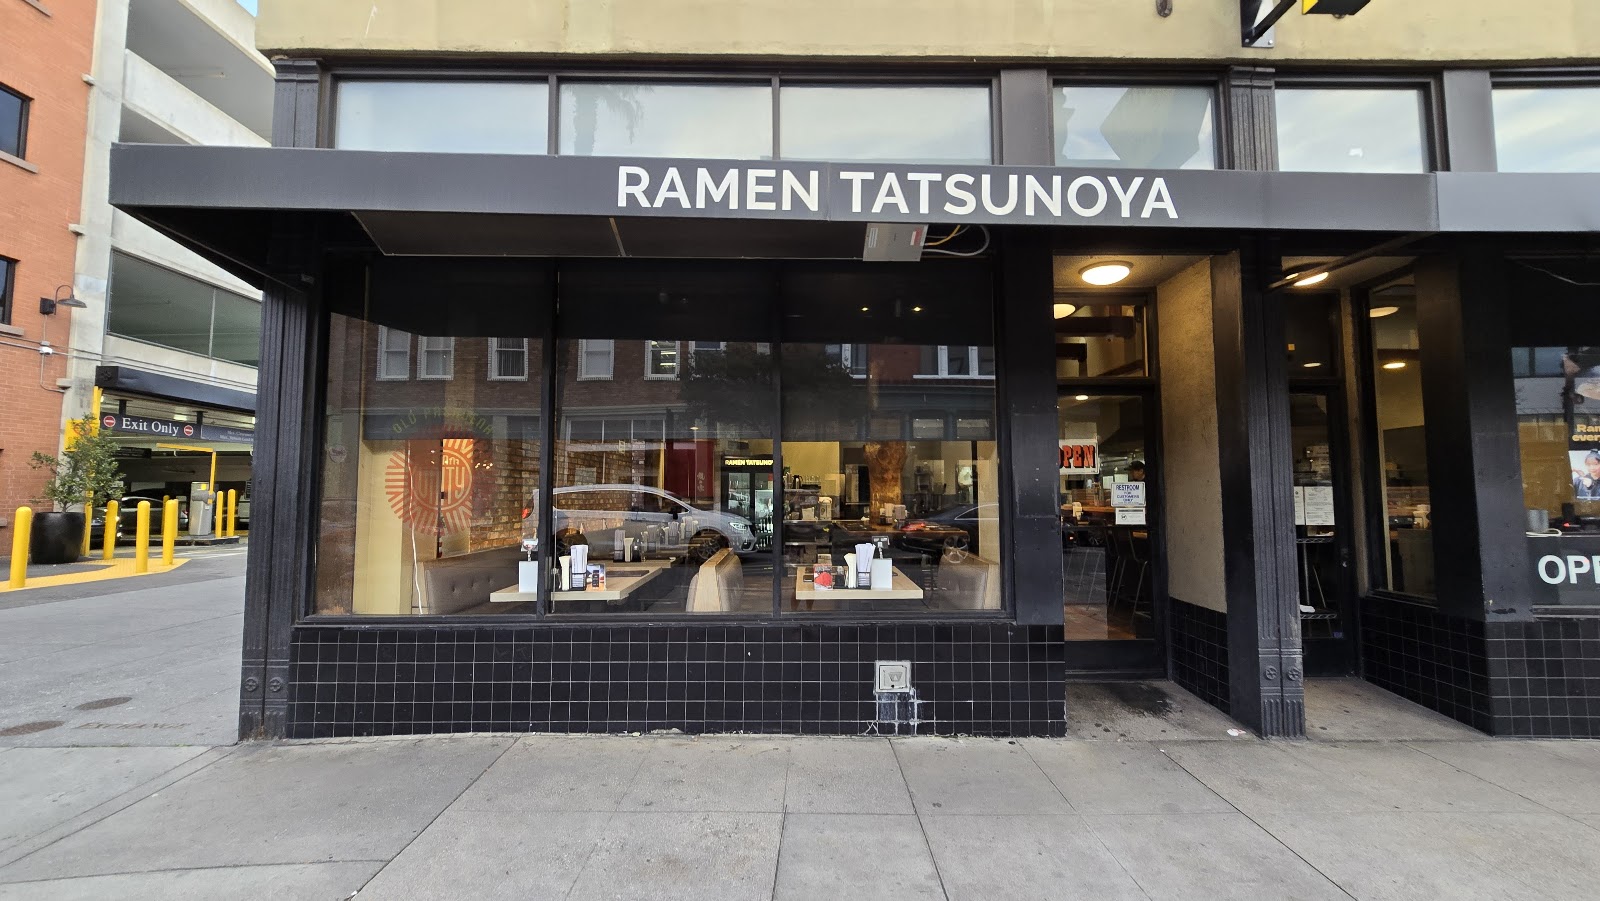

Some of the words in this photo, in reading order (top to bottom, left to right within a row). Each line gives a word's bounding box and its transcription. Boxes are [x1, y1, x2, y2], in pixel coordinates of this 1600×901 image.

[617, 166, 819, 212] RAMEN
[839, 171, 1179, 219] TATSUNOYA
[122, 417, 147, 431] Exit
[151, 421, 179, 436] Only
[1059, 445, 1096, 468] PEN
